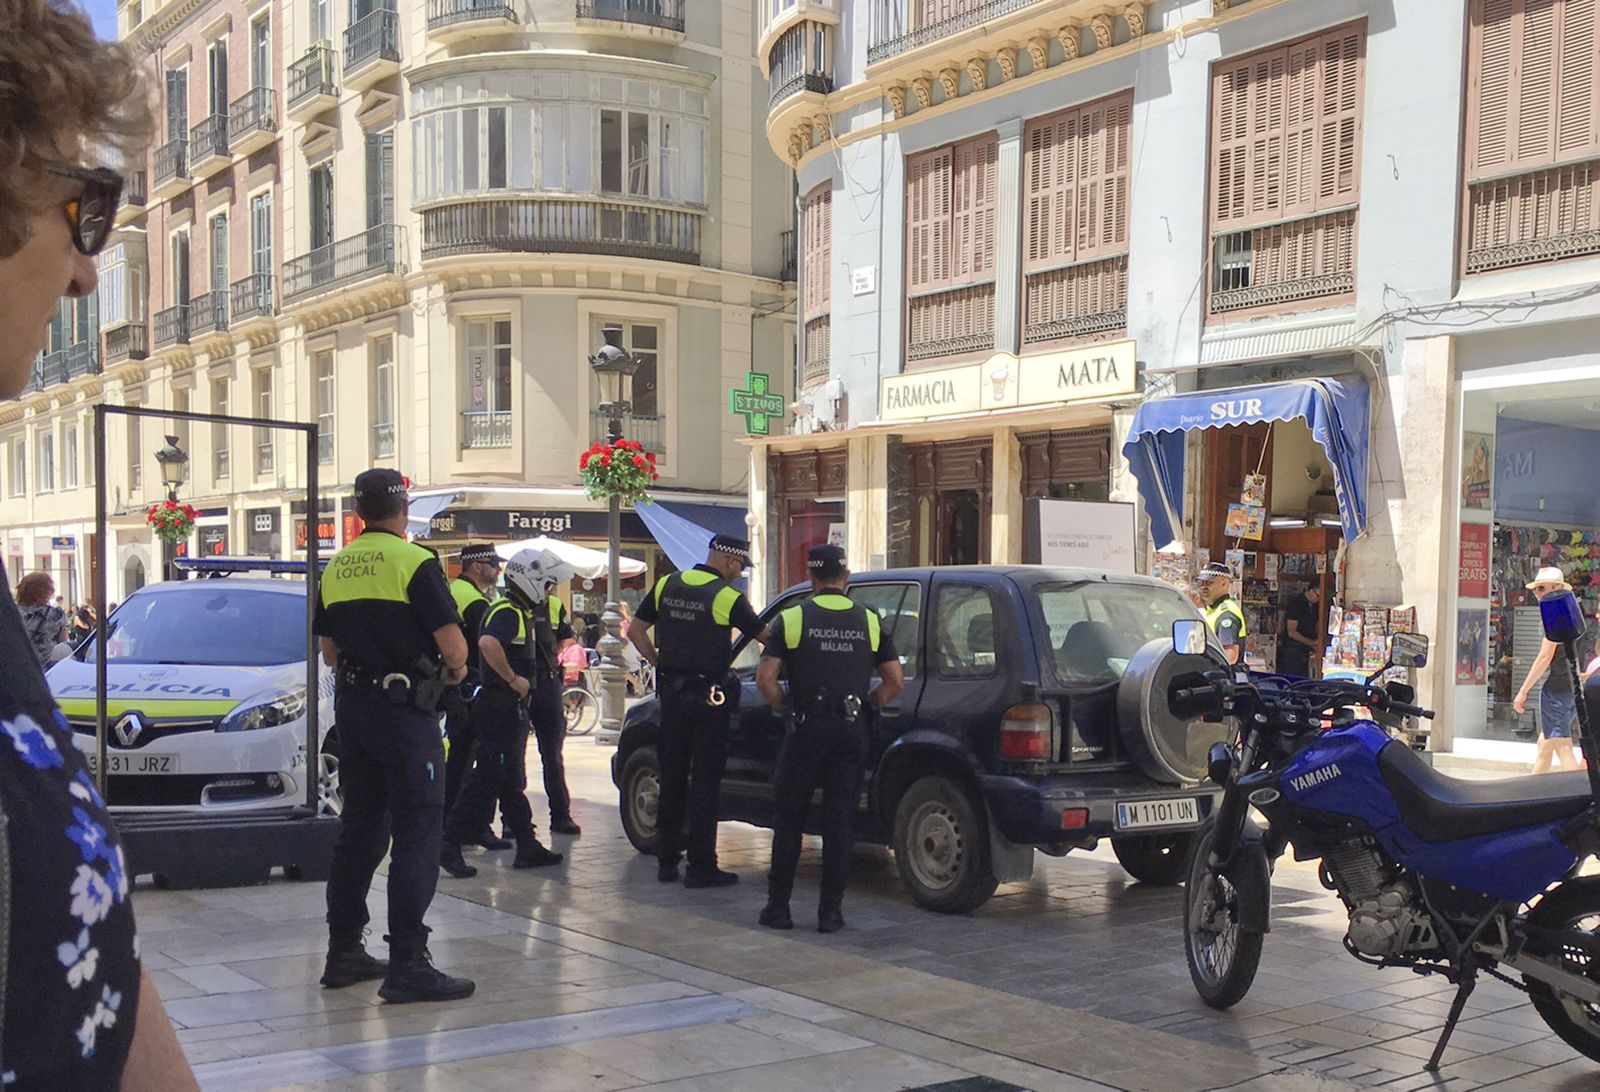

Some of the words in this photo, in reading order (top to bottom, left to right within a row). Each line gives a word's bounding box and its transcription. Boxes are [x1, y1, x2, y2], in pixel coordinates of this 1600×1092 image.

[886, 380, 956, 410] FARMACIA
[1057, 356, 1120, 388] MATA
[1210, 398, 1263, 420] SUR
[430, 514, 455, 532] arggi
[507, 512, 572, 532] Farggi
[336, 565, 377, 580] LOCAL
[1459, 568, 1488, 580] GRATIS
[686, 600, 706, 612] LOCAL
[840, 630, 866, 641] LOCAL
[58, 682, 231, 698] POLICIA
[89, 756, 130, 772] 331
[138, 757, 170, 772] JRZ
[1290, 763, 1342, 792] YAMAHA
[1128, 805, 1139, 824] M
[1143, 803, 1173, 822] 1101
[1176, 801, 1194, 819] UN
